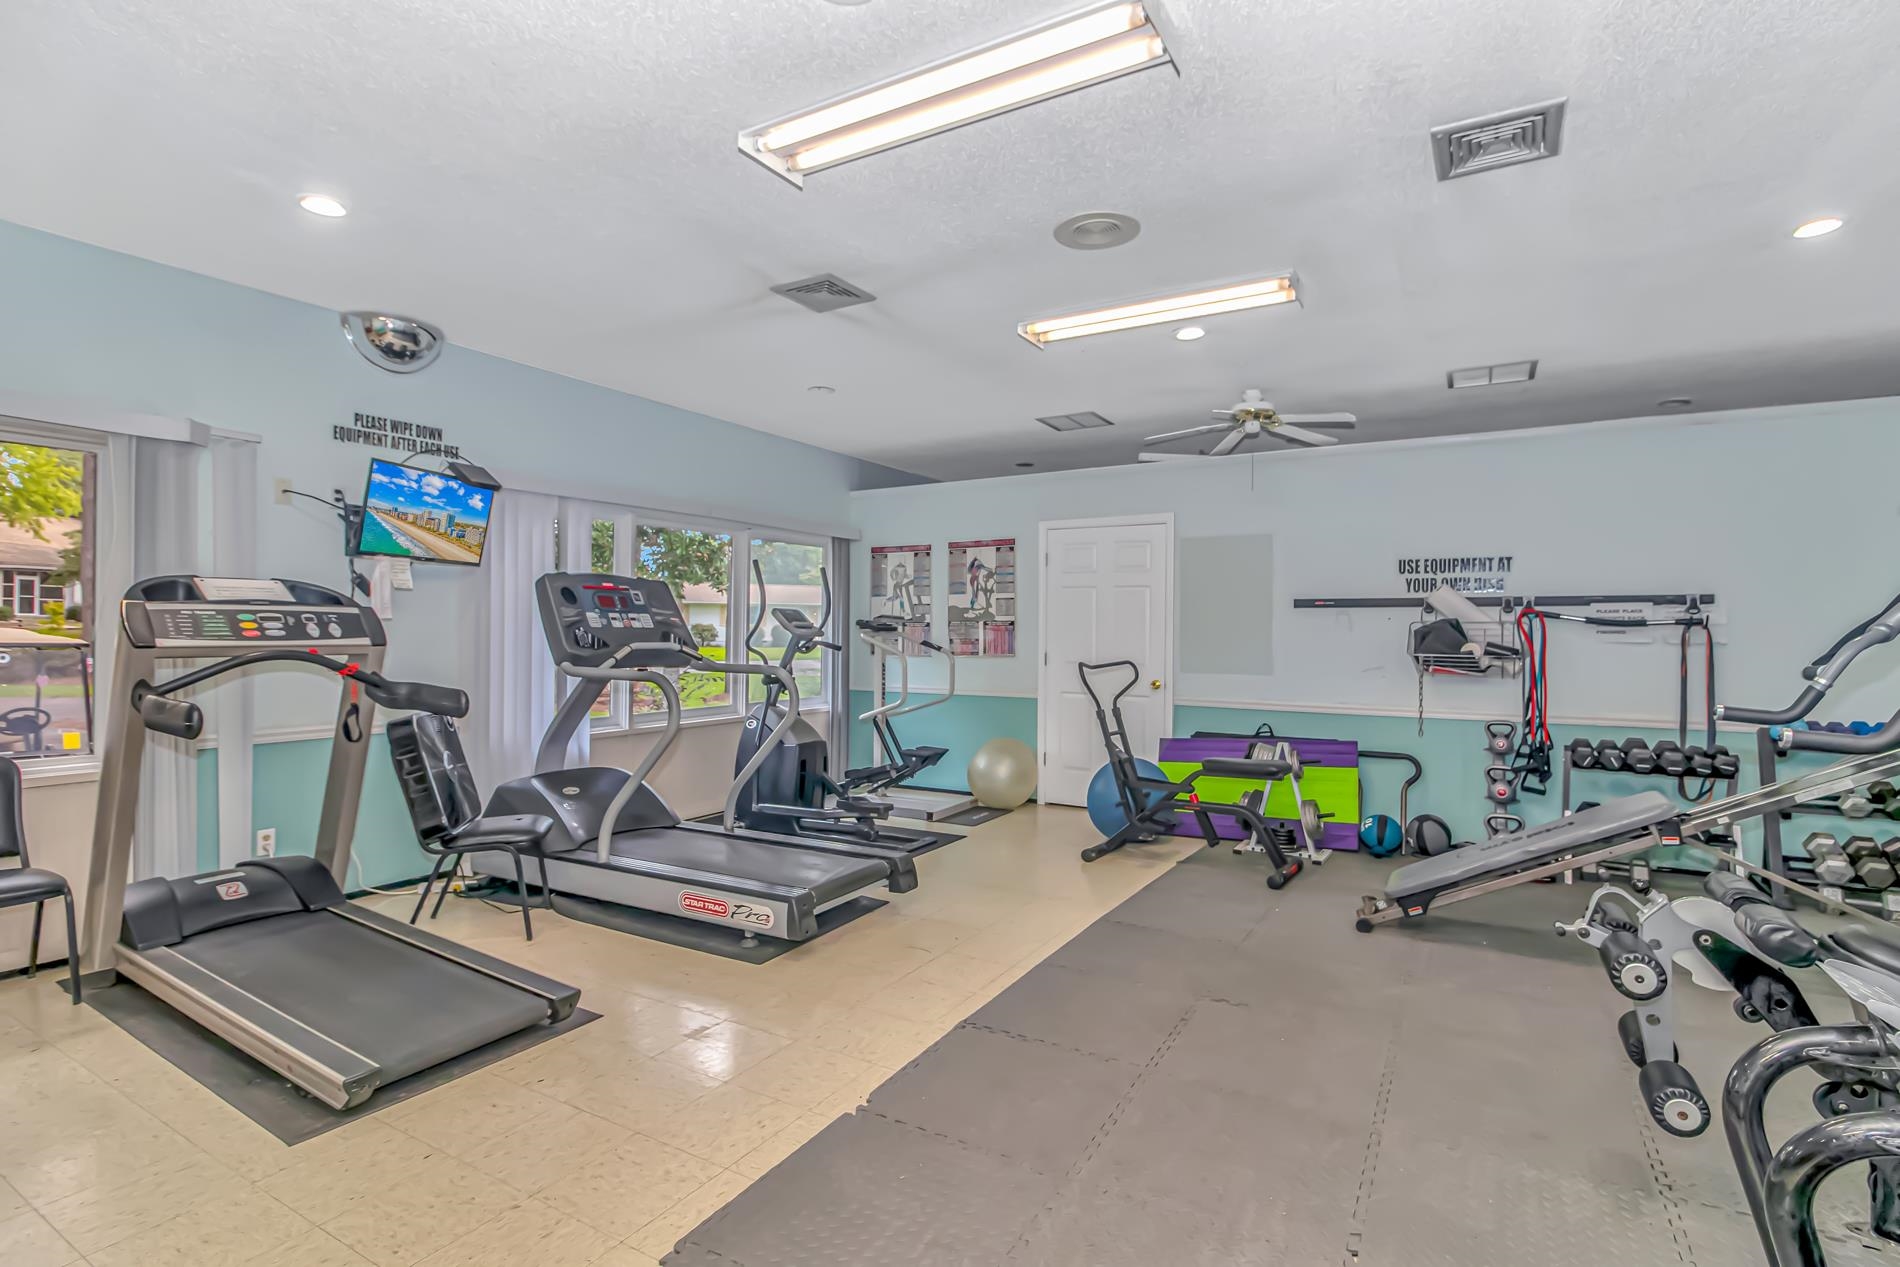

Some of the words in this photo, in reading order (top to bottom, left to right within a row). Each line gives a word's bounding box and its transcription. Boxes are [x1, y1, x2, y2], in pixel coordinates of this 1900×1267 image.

[354, 412, 388, 432] PLEASE
[390, 419, 414, 437] WIPE
[416, 423, 443, 442] DOWN
[333, 425, 388, 449] EQUIPMENT
[391, 435, 417, 453] AFTER
[420, 441, 442, 457] EACH
[444, 444, 460, 460] USE
[1398, 559, 1421, 575] USE
[1423, 557, 1495, 576] EQUIPMENT
[1497, 556, 1513, 572] AT
[1405, 577, 1437, 593] YOUR
[683, 898, 703, 909] STAR
[703, 902, 726, 913] TRAC
[731, 904, 770, 922] Pro
